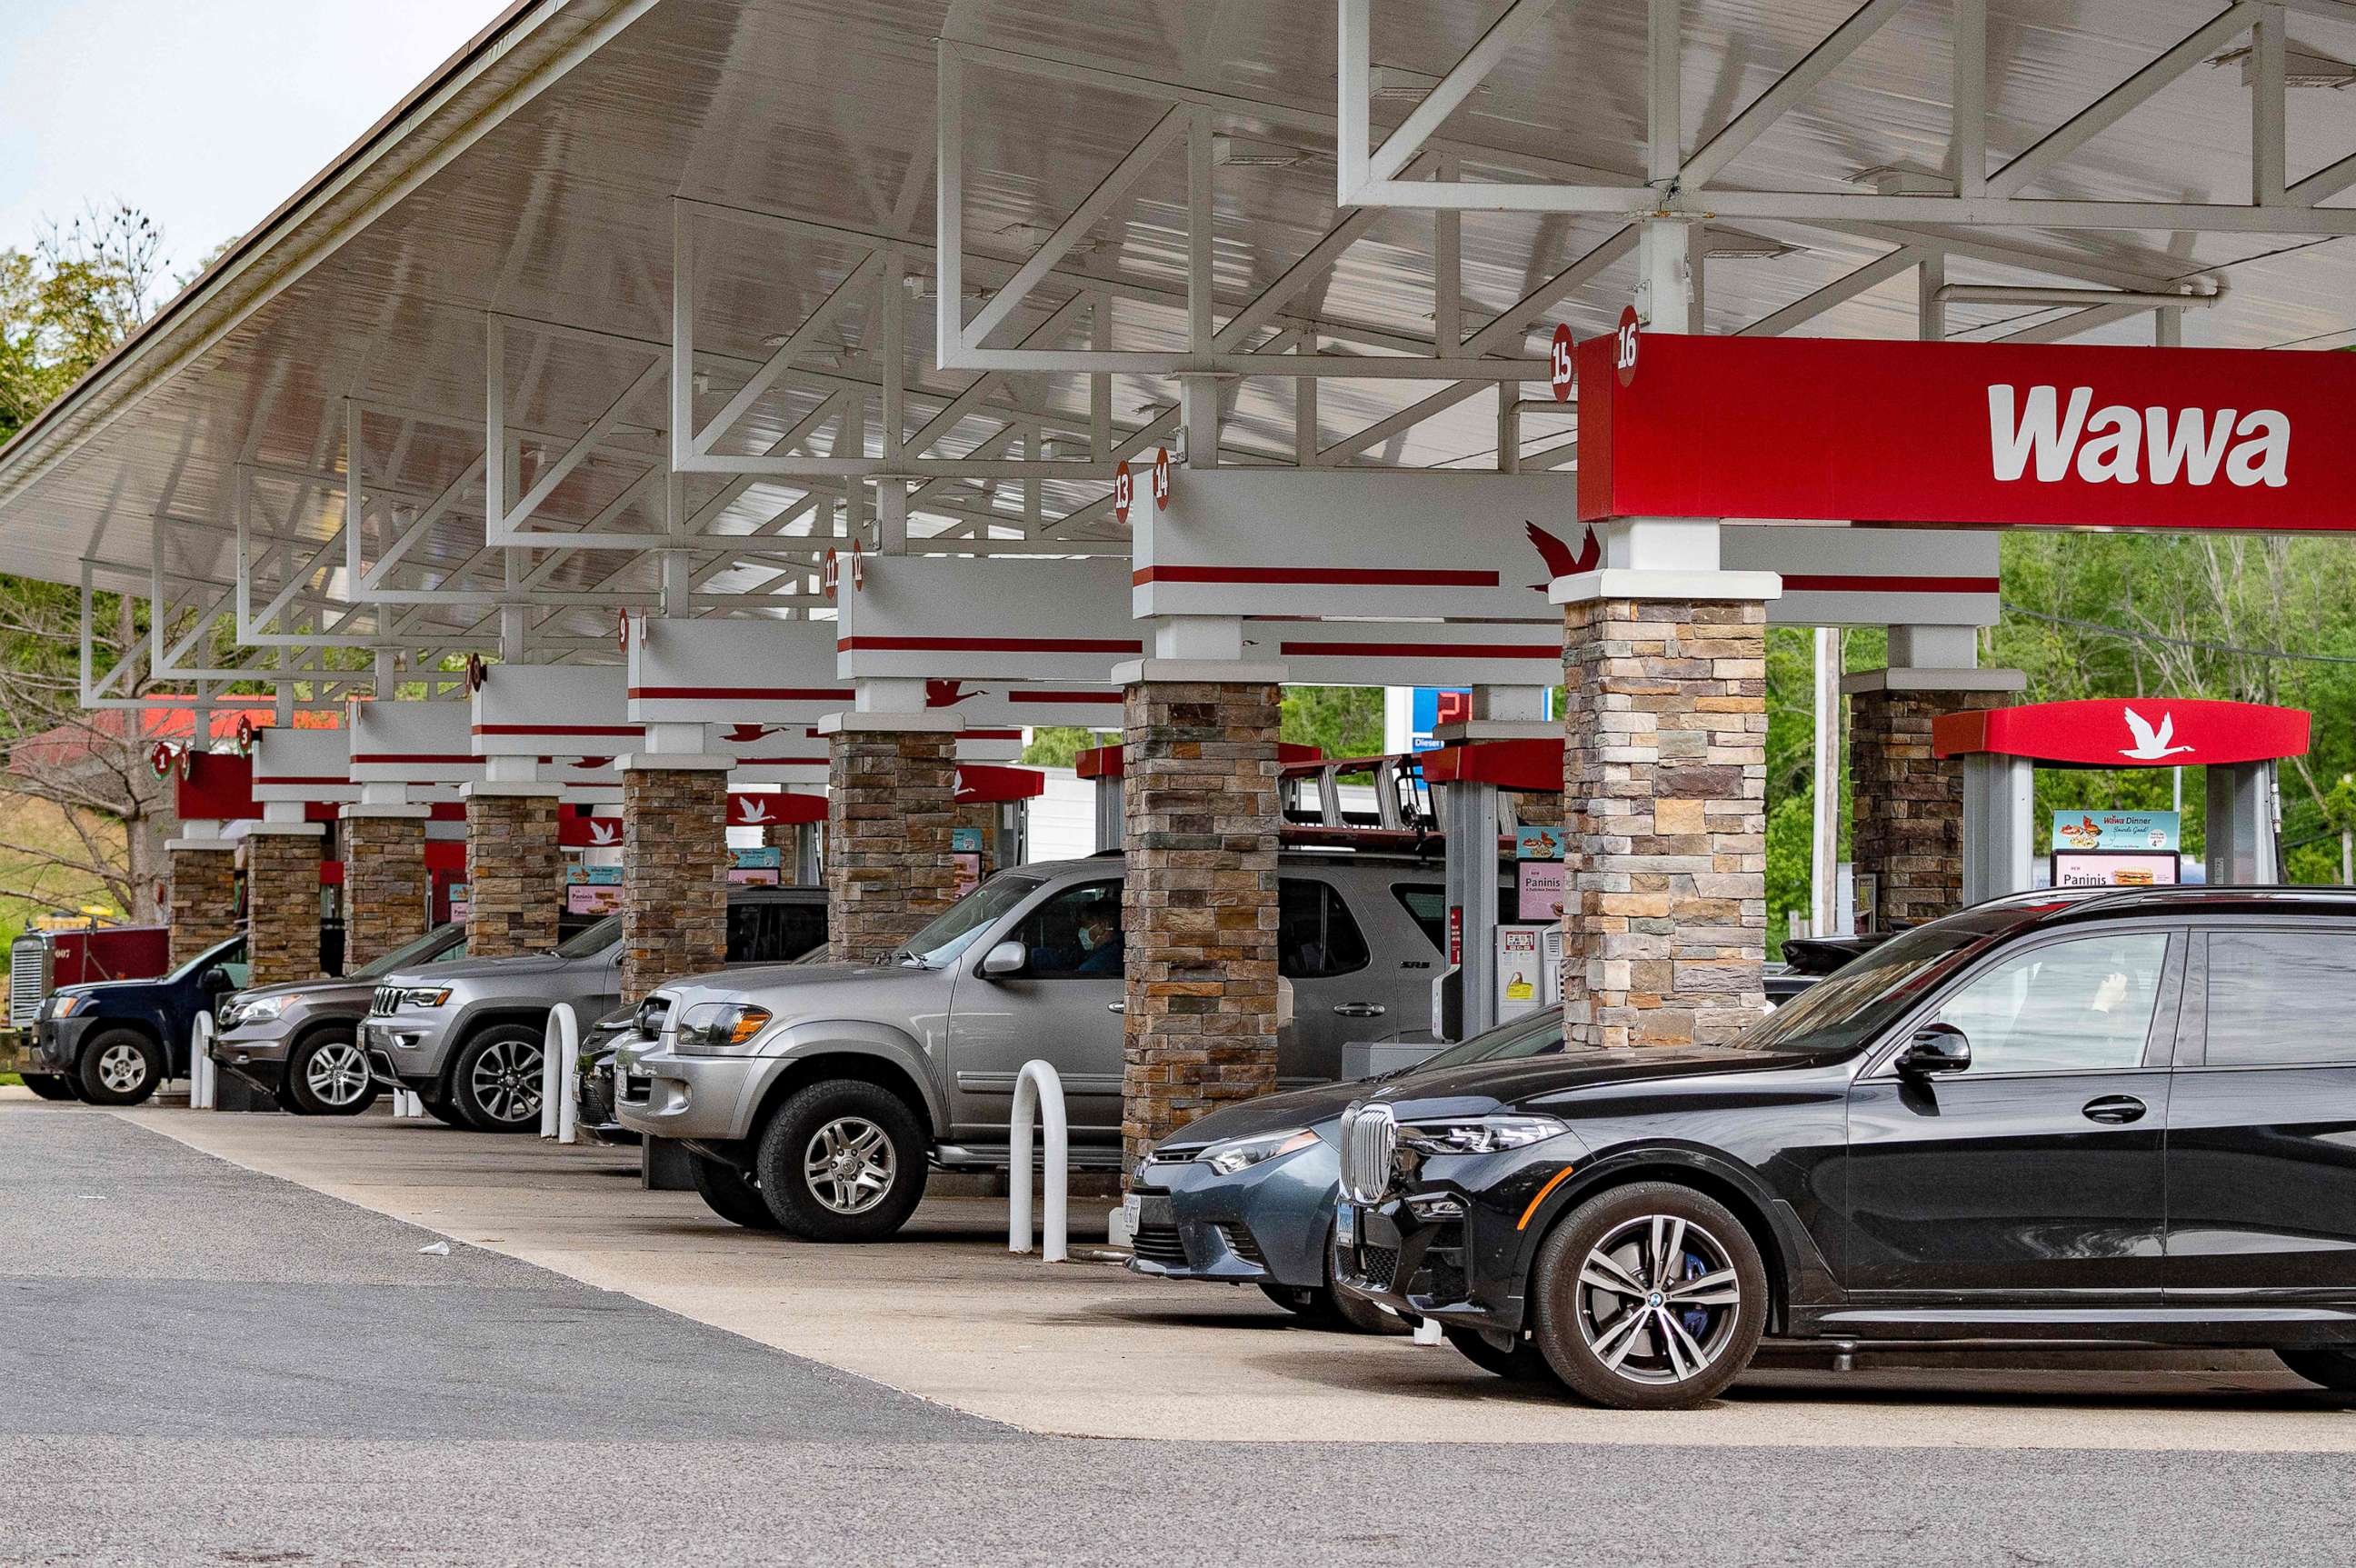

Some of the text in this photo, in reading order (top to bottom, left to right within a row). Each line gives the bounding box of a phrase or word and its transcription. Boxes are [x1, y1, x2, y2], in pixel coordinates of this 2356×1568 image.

[1618, 323, 1636, 369] 16
[1552, 342, 1572, 385] 15
[1988, 384, 2291, 487] Wawa
[1116, 474, 1129, 508] 13
[1155, 462, 1168, 498] 14
[825, 559, 835, 587] 11
[620, 617, 626, 643] 9
[474, 661, 480, 683] 8
[242, 727, 248, 744] 3
[158, 753, 166, 769] 1
[2103, 815, 2151, 825] Wawa Dinner
[1525, 877, 1561, 887] Paninis
[2063, 874, 2107, 886] Paninis
